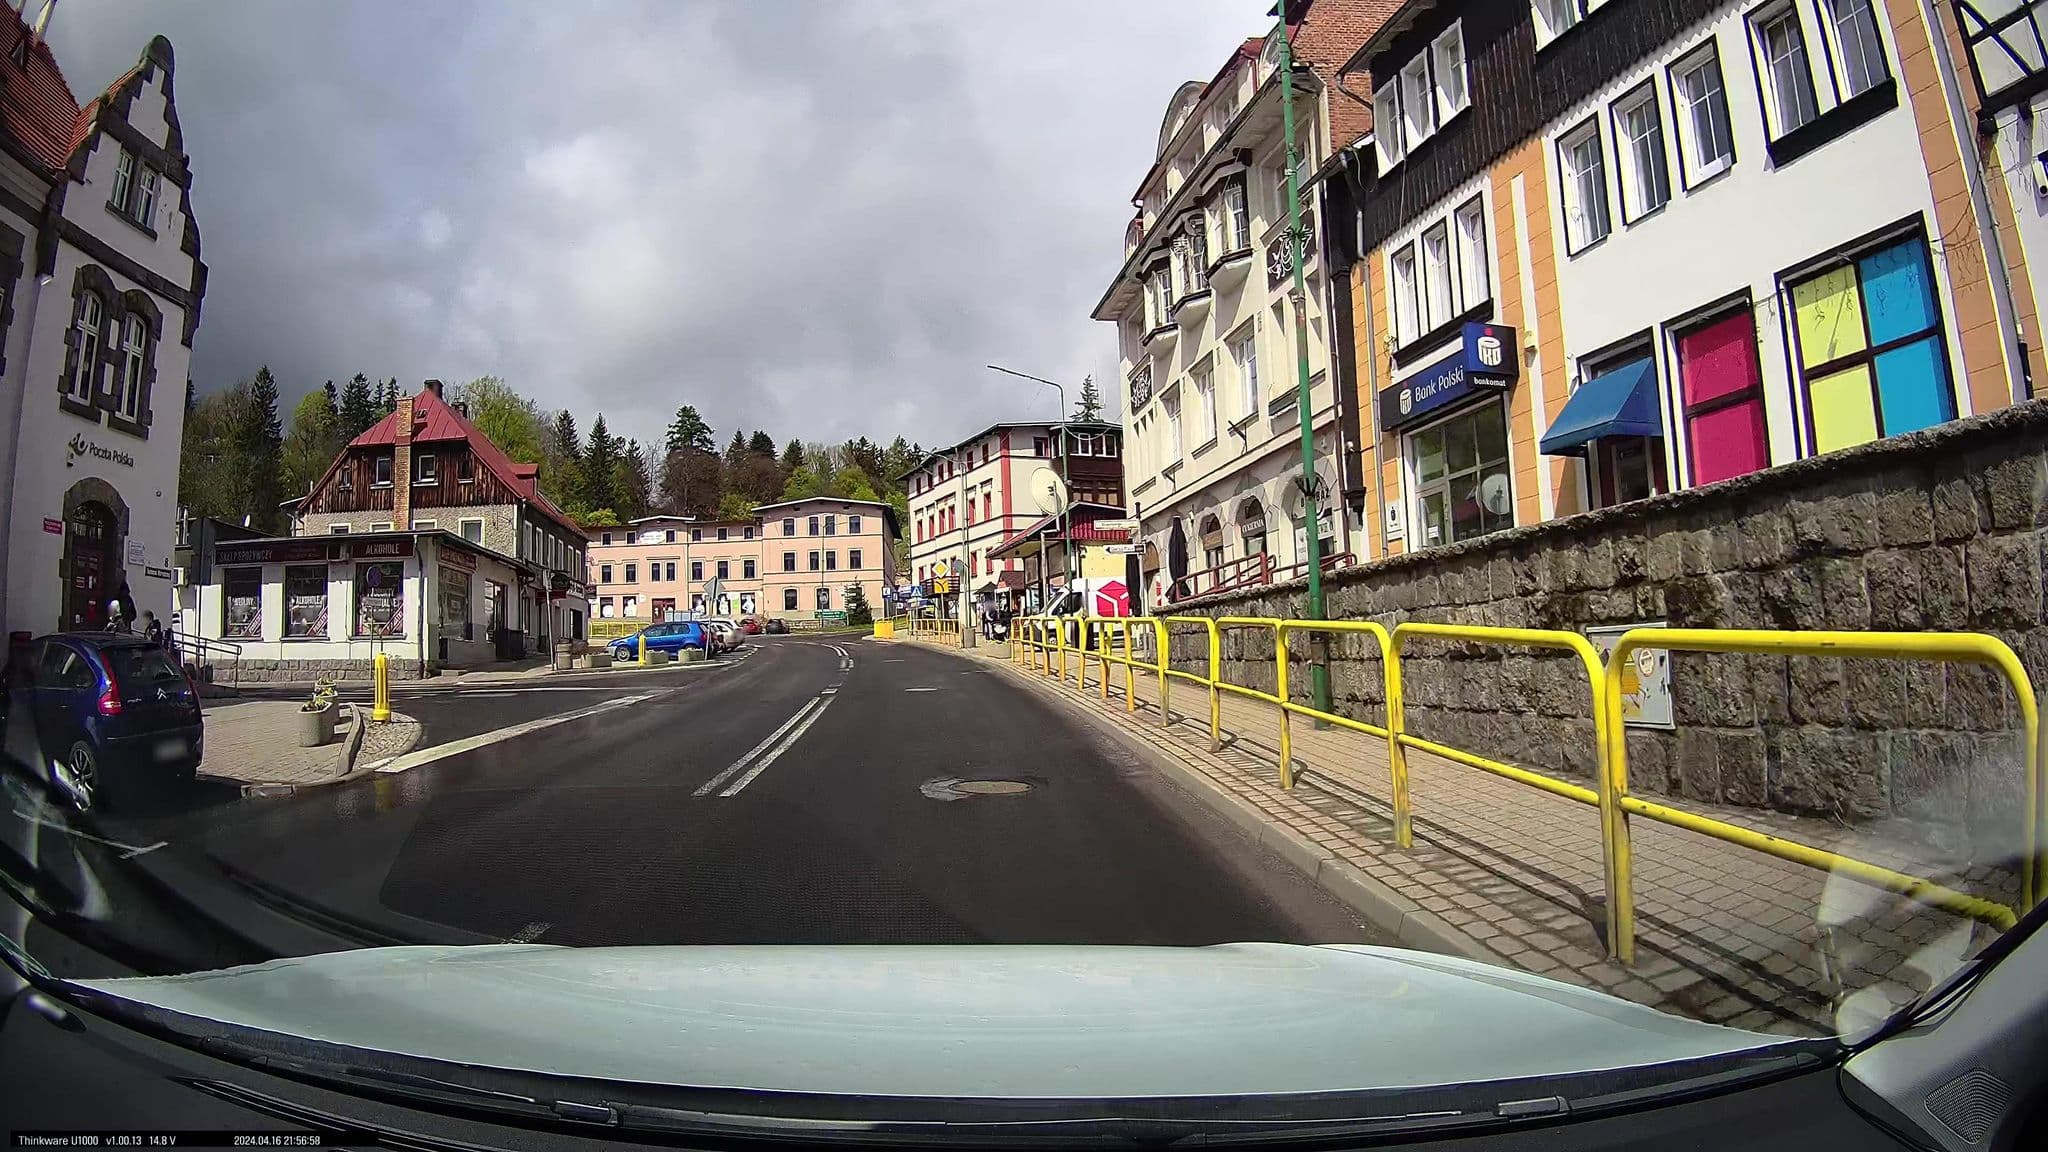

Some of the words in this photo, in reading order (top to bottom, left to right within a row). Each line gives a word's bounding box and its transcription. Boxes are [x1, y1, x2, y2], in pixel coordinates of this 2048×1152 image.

[1415, 380, 1437, 402] Bank
[1438, 365, 1464, 392] Polski
[1474, 377, 1506, 387] bankomat
[89, 442, 112, 462] Poczta
[112, 450, 134, 467] Polska
[366, 543, 400, 555] ALKOHOLE
[164, 558, 169, 568] 8
